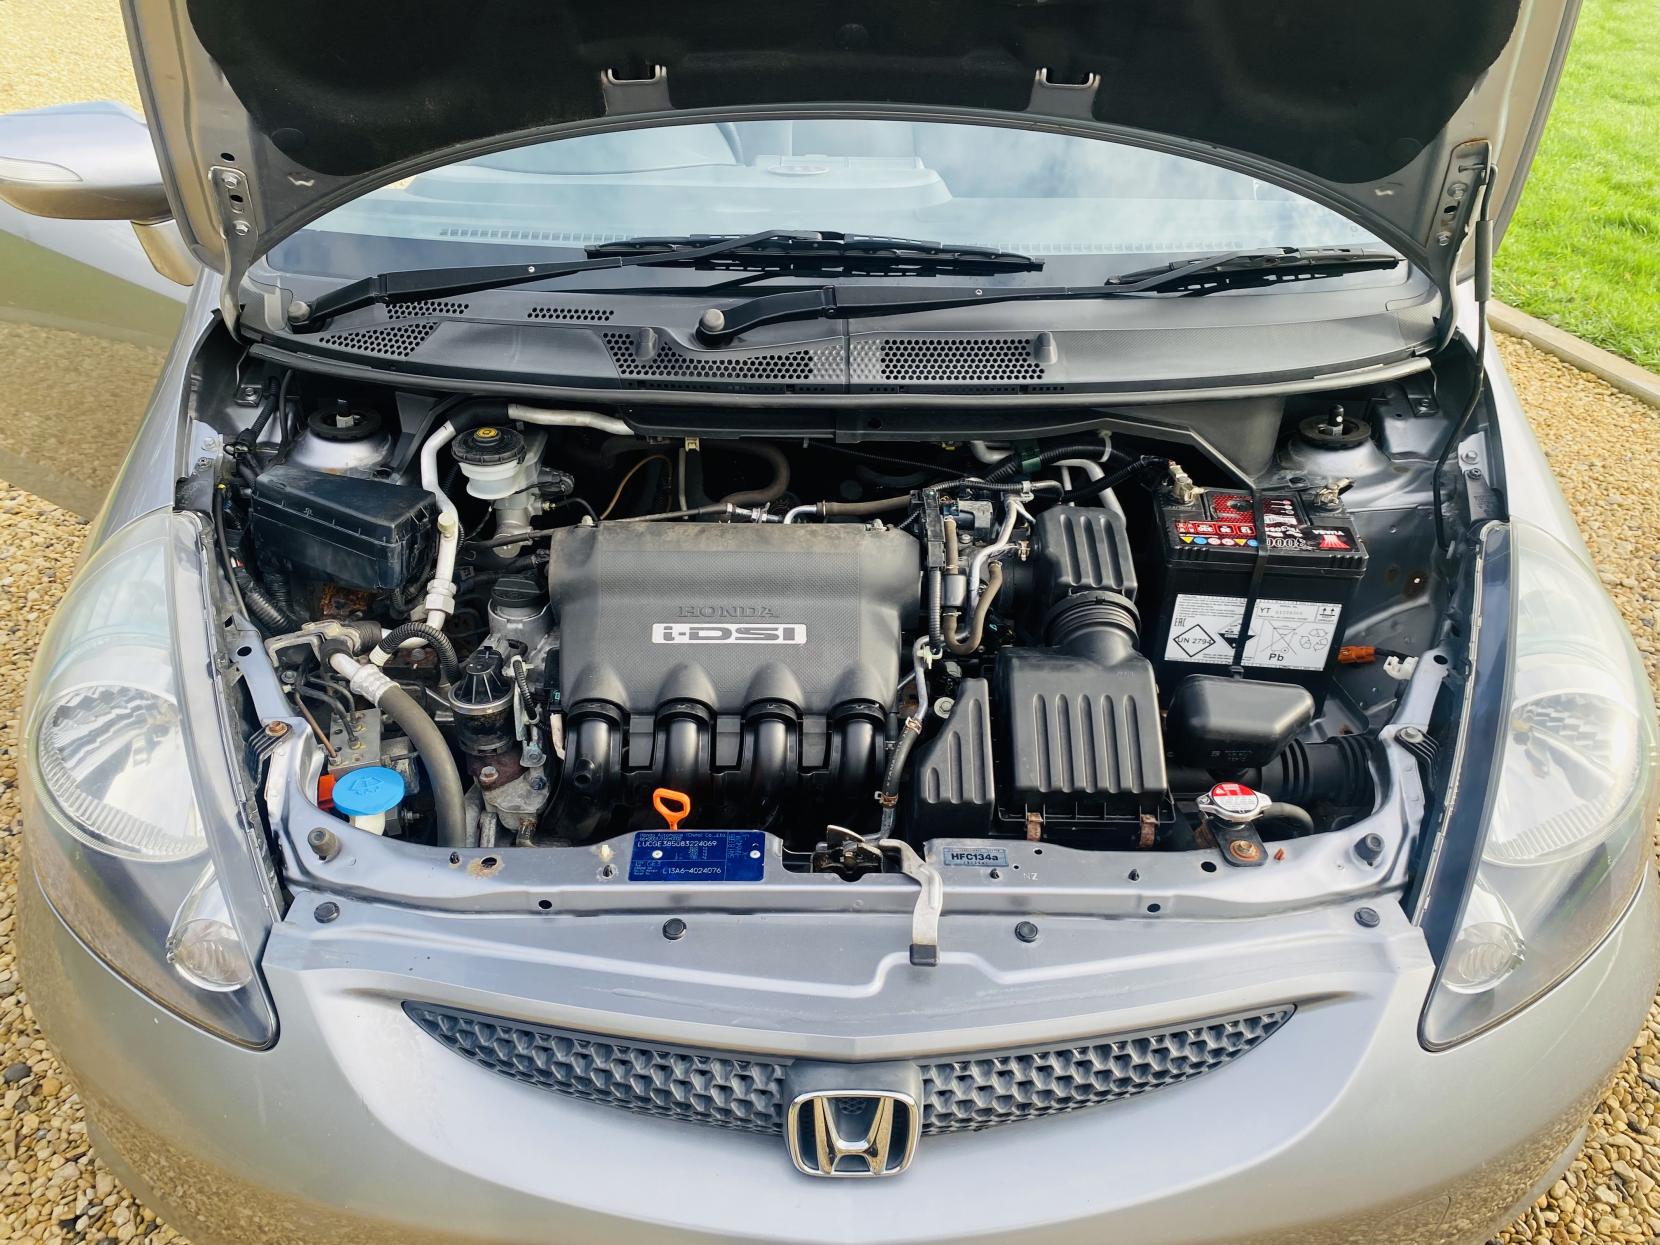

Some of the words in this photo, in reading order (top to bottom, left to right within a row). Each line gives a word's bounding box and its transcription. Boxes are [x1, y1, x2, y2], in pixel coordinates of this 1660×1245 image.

[677, 606, 780, 618] HONDA
[663, 625, 796, 642] i-DSI
[1177, 636, 1190, 644] UN
[1269, 653, 1285, 662] Pb
[951, 852, 999, 861] HFC134a
